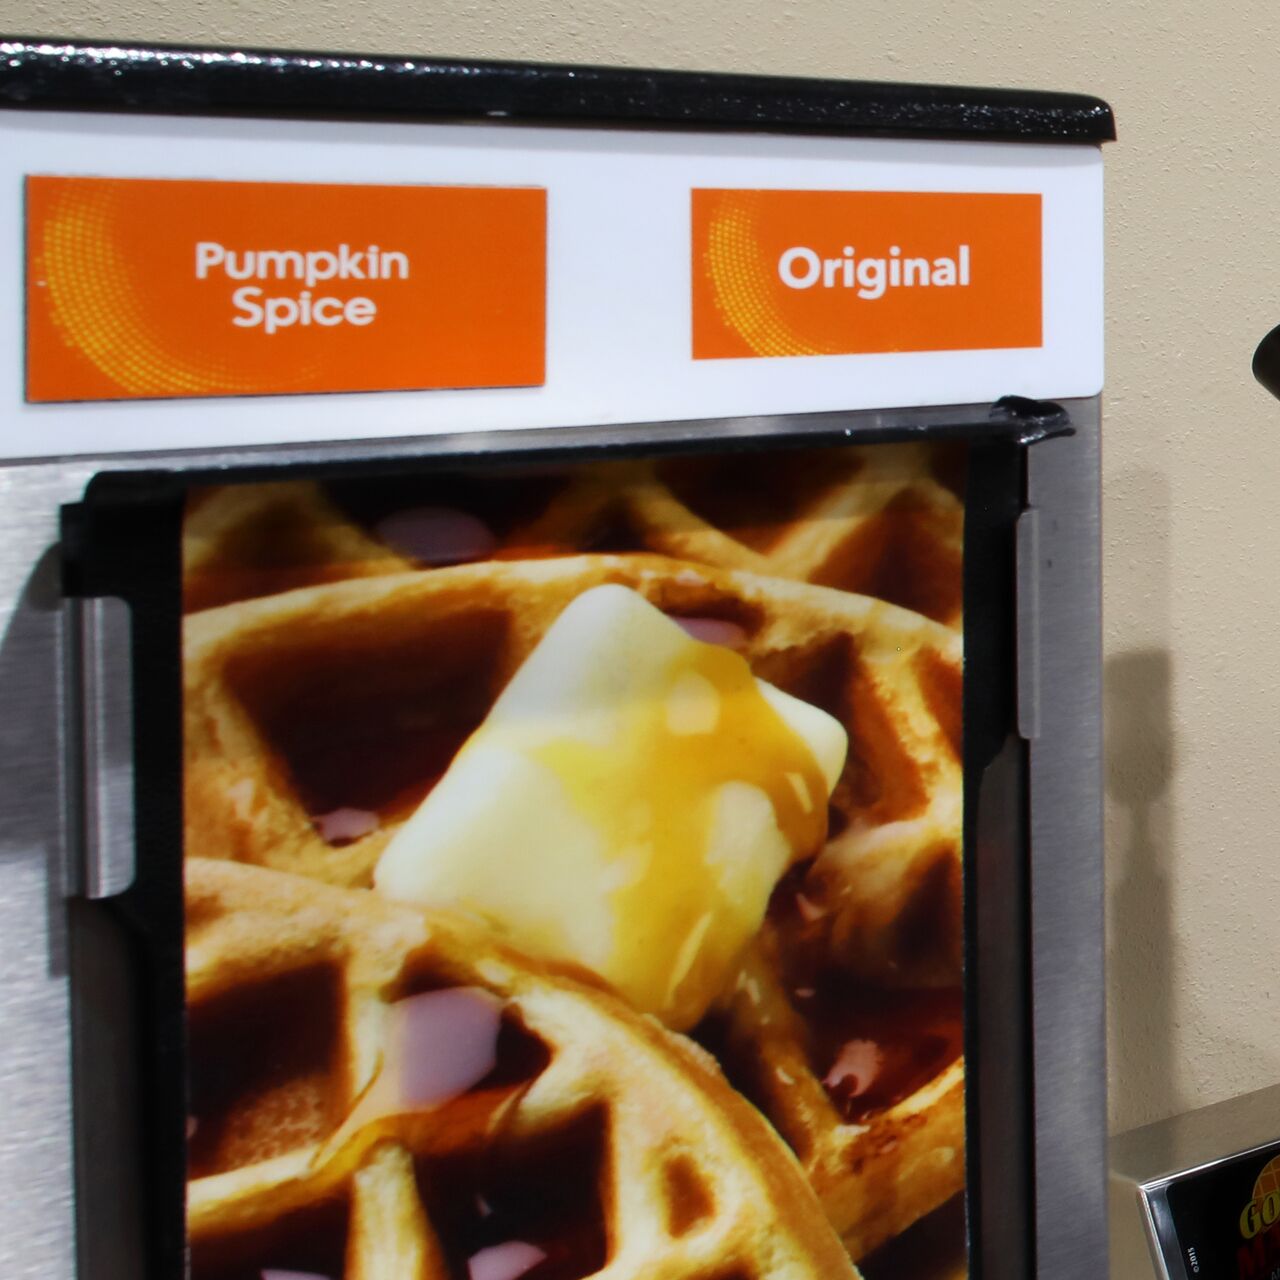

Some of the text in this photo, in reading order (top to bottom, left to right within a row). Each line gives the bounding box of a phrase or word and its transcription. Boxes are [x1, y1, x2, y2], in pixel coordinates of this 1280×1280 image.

[195, 241, 409, 288] Pumpkin
[778, 244, 970, 300] Original
[232, 286, 377, 335] Spice
